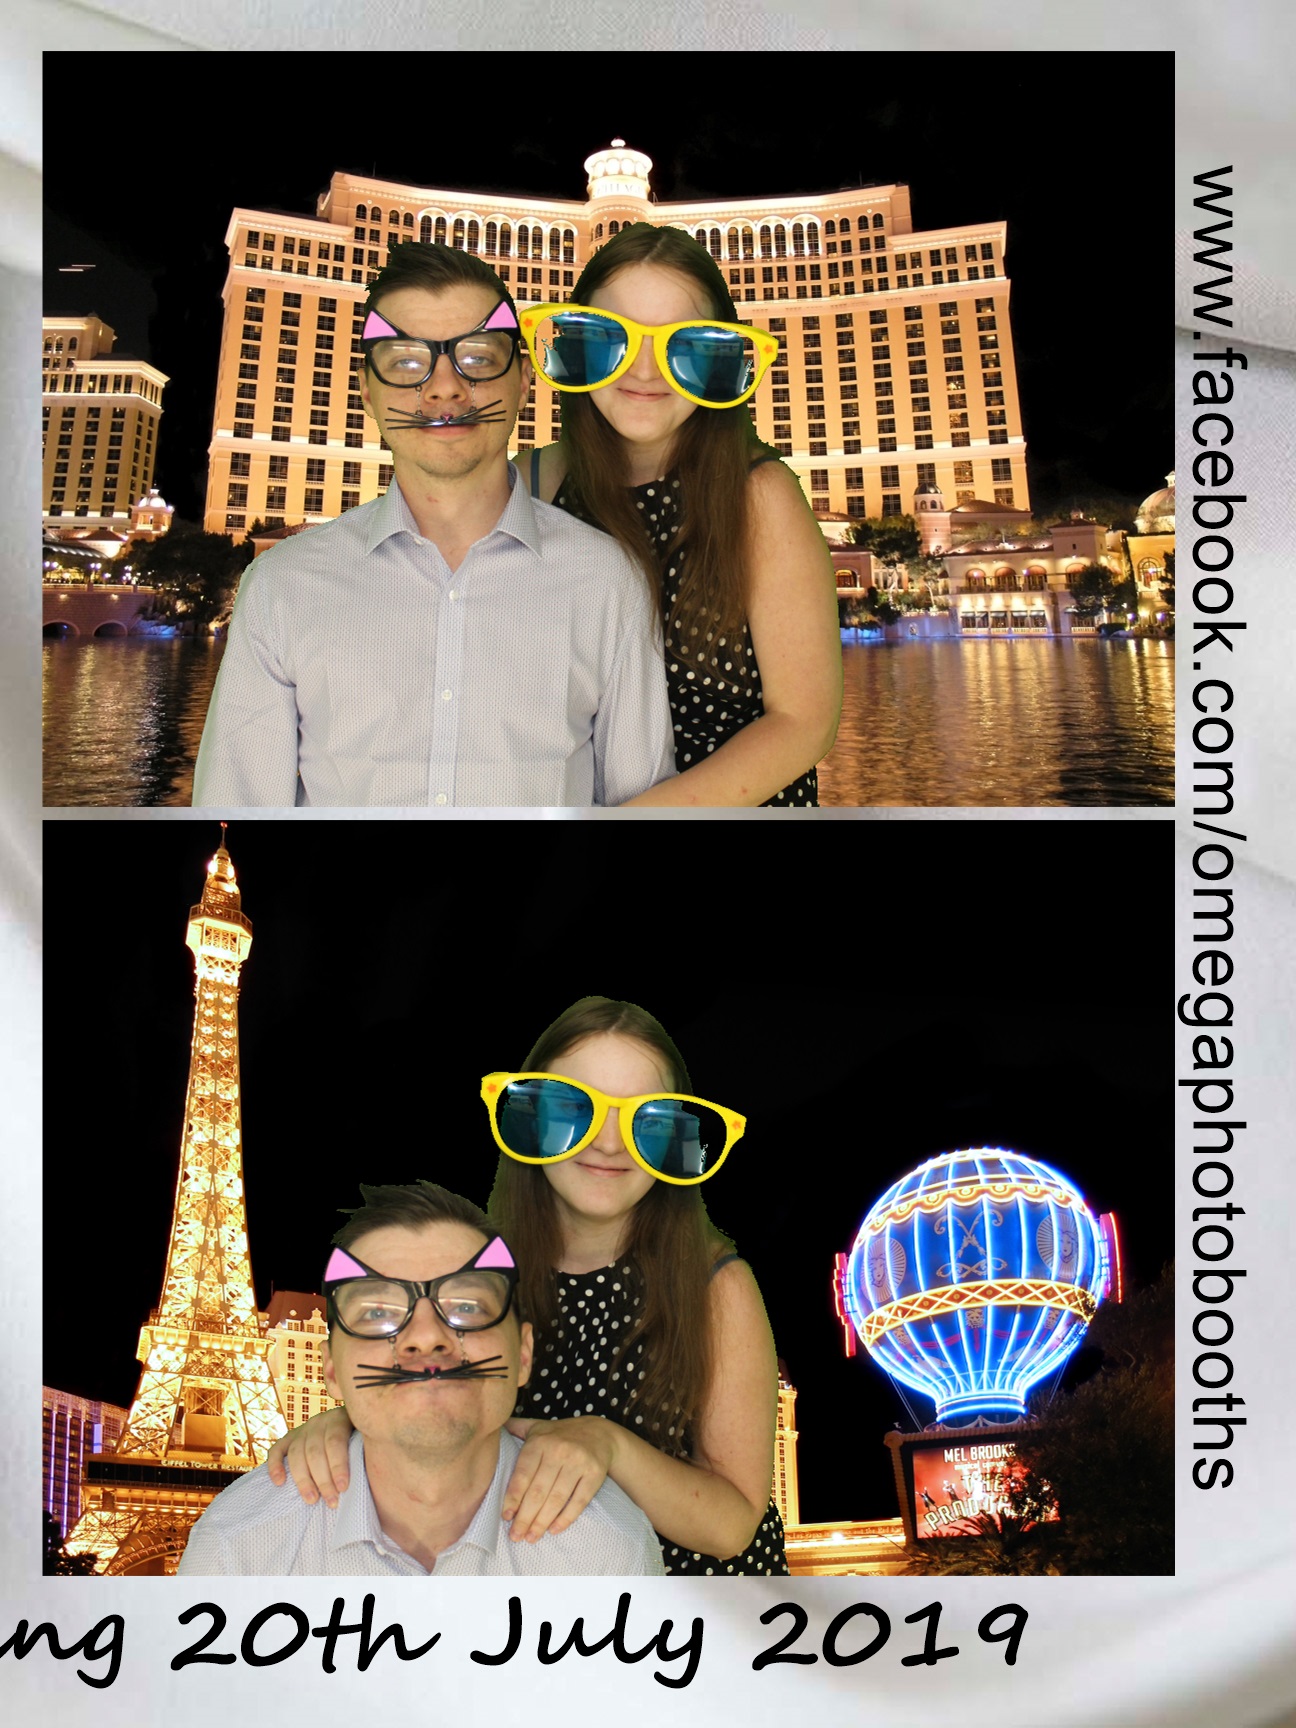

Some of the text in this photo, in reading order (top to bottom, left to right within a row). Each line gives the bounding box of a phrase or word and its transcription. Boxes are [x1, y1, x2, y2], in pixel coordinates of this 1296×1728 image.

[944, 1449, 968, 1463] MEL
[160, 1459, 189, 1468] EIFFEL
[190, 1461, 218, 1470] TOWER
